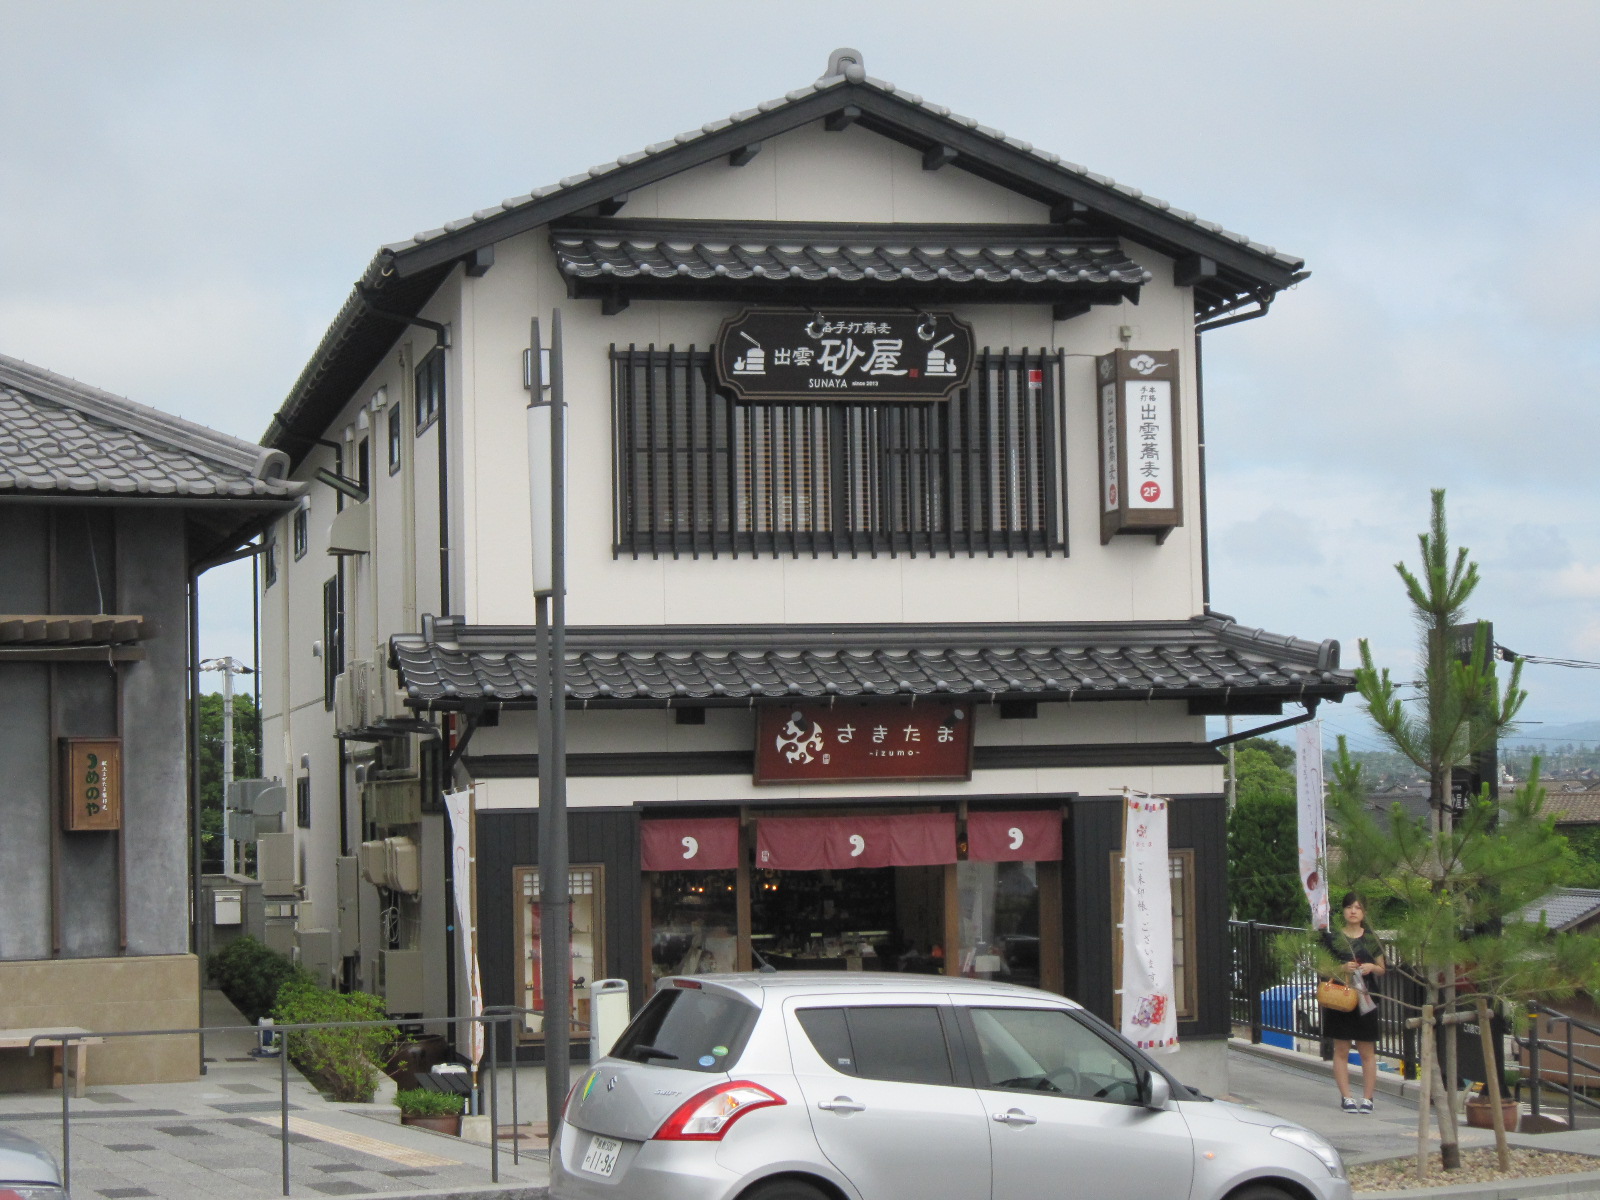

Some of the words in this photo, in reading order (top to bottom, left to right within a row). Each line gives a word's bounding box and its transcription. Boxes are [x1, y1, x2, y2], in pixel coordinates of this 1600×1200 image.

[774, 347, 814, 367] 出雲
[816, 337, 909, 377] 砂屋
[808, 378, 848, 388] SUNAYA
[1139, 404, 1160, 478] 出雲蕎麦
[1143, 486, 1157, 497] 2F
